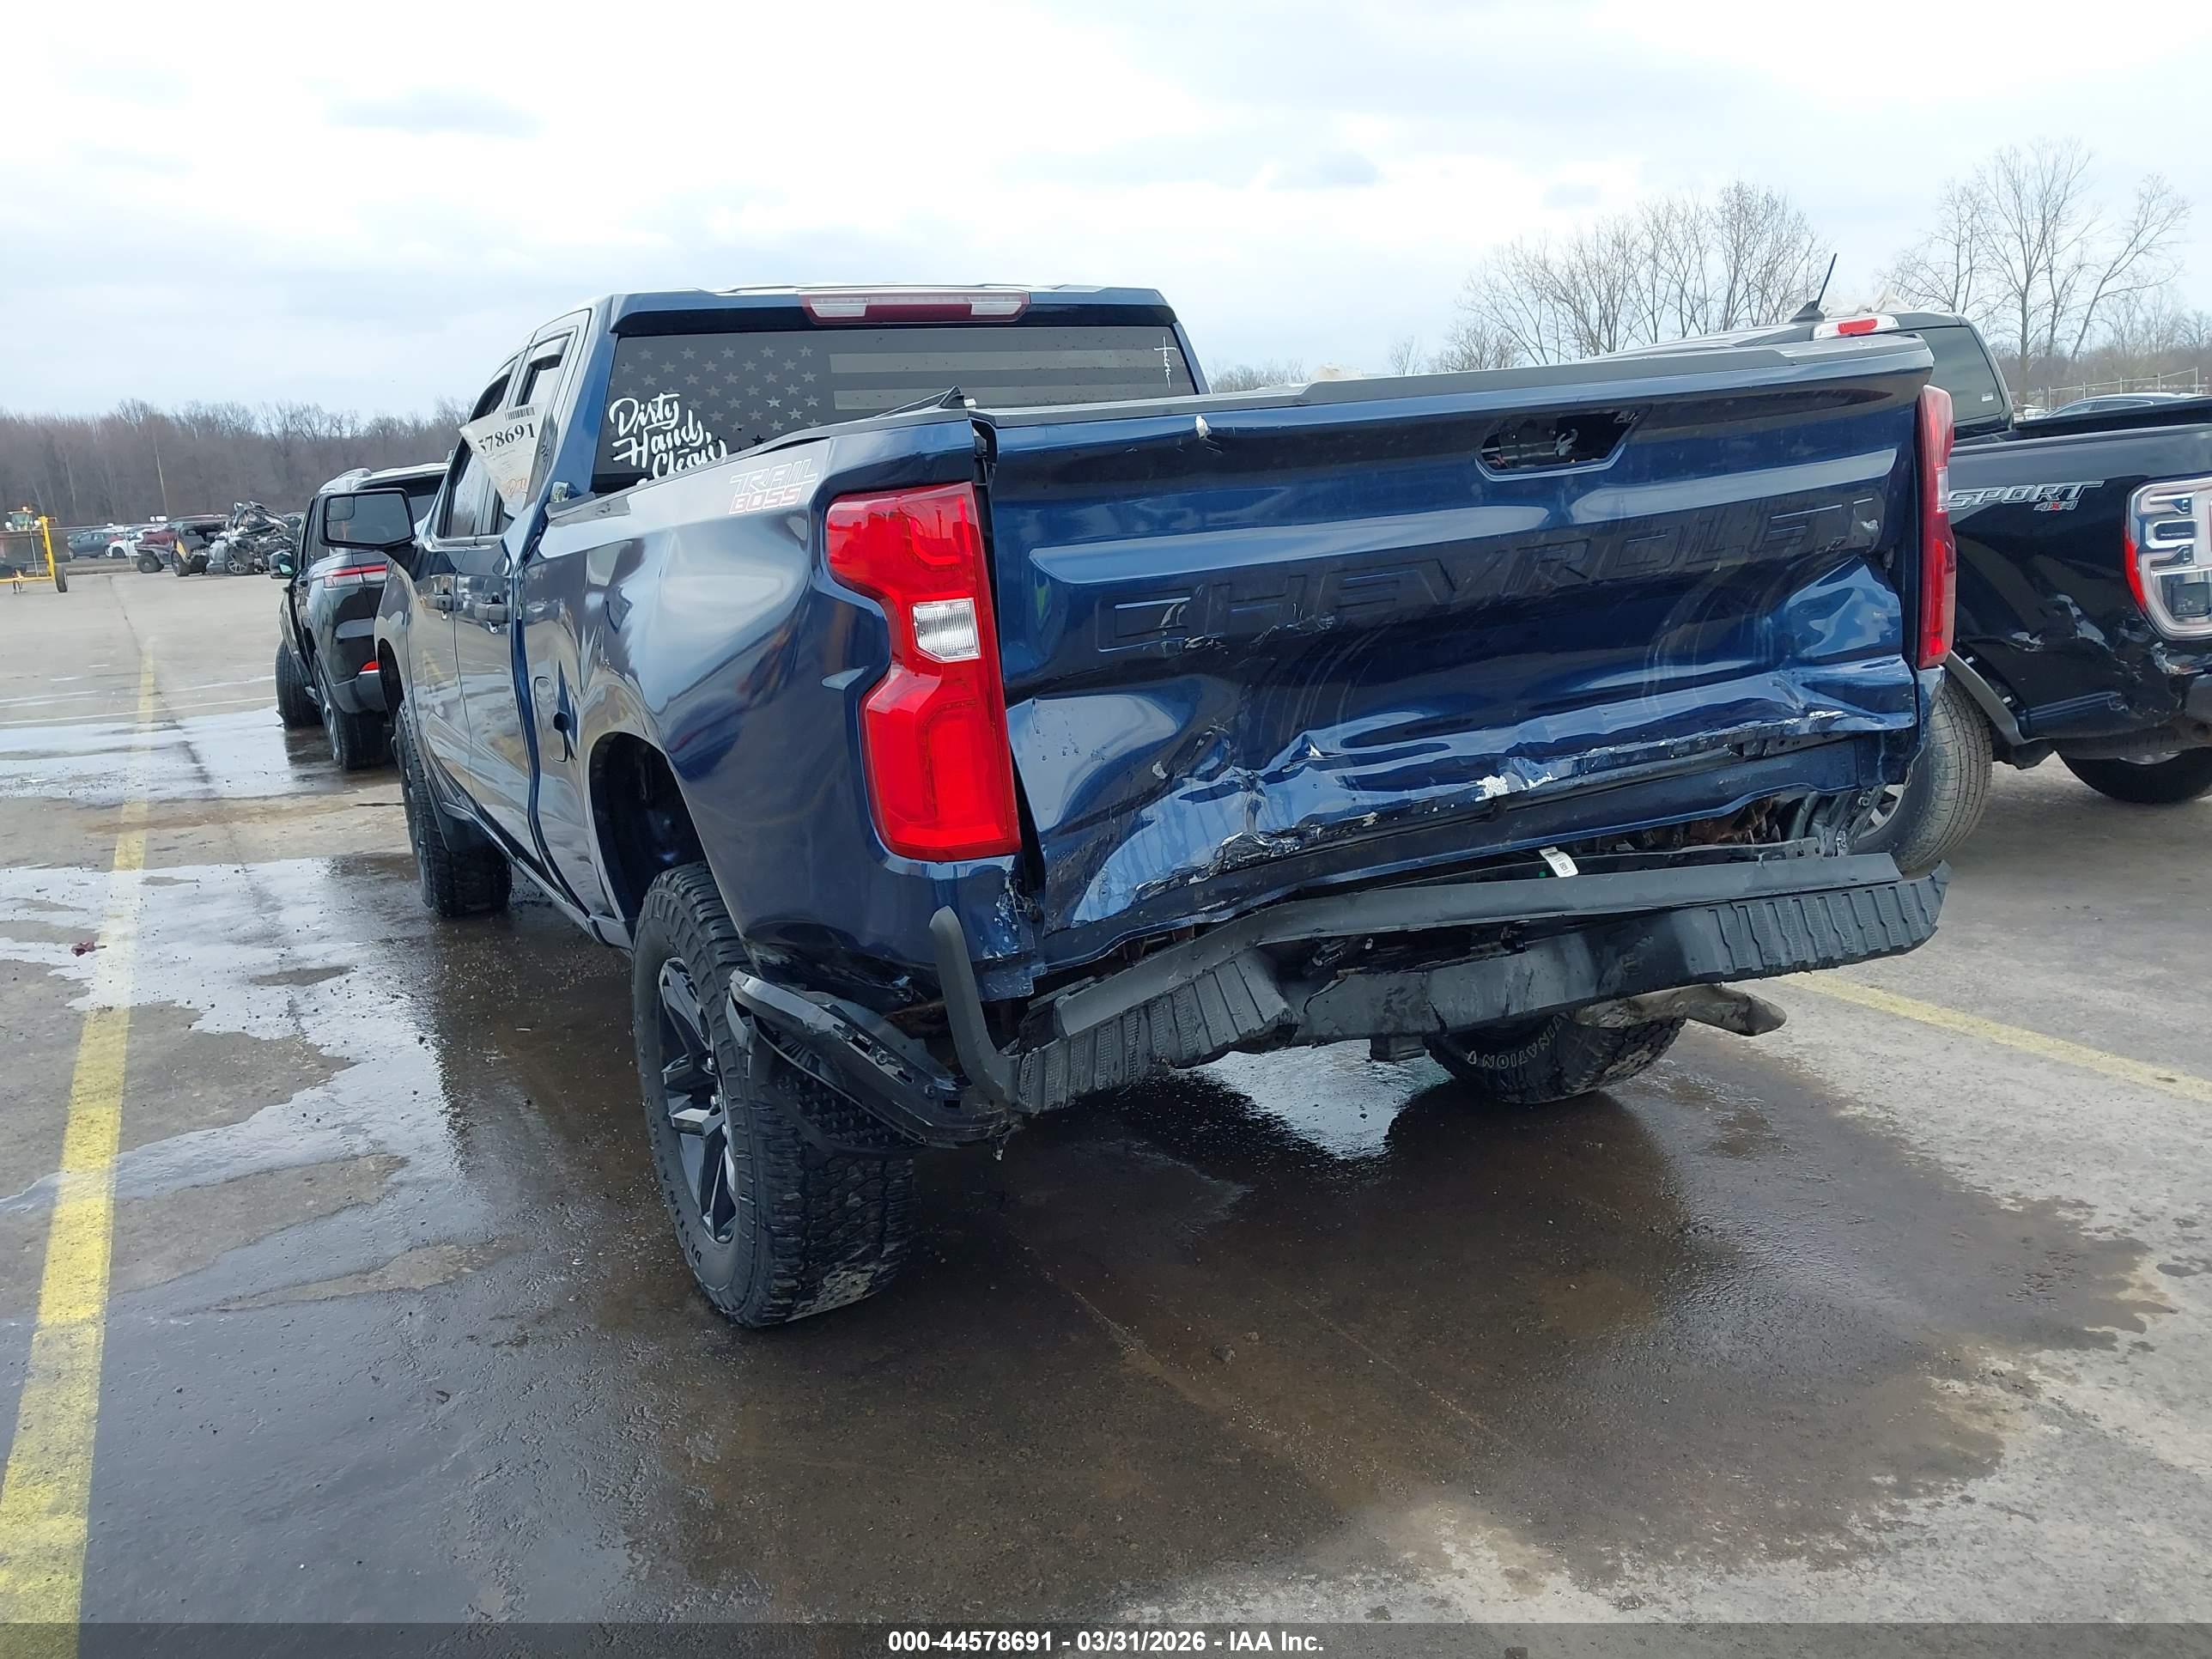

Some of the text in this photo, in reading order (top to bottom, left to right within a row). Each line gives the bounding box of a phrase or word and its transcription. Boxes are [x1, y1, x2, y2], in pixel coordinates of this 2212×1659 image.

[608, 392, 680, 437] Dirty
[729, 458, 818, 496] TRAIL
[1948, 481, 2106, 510] SPORT
[728, 485, 803, 514] BOSS
[1096, 489, 1881, 652] CHEVROLET
